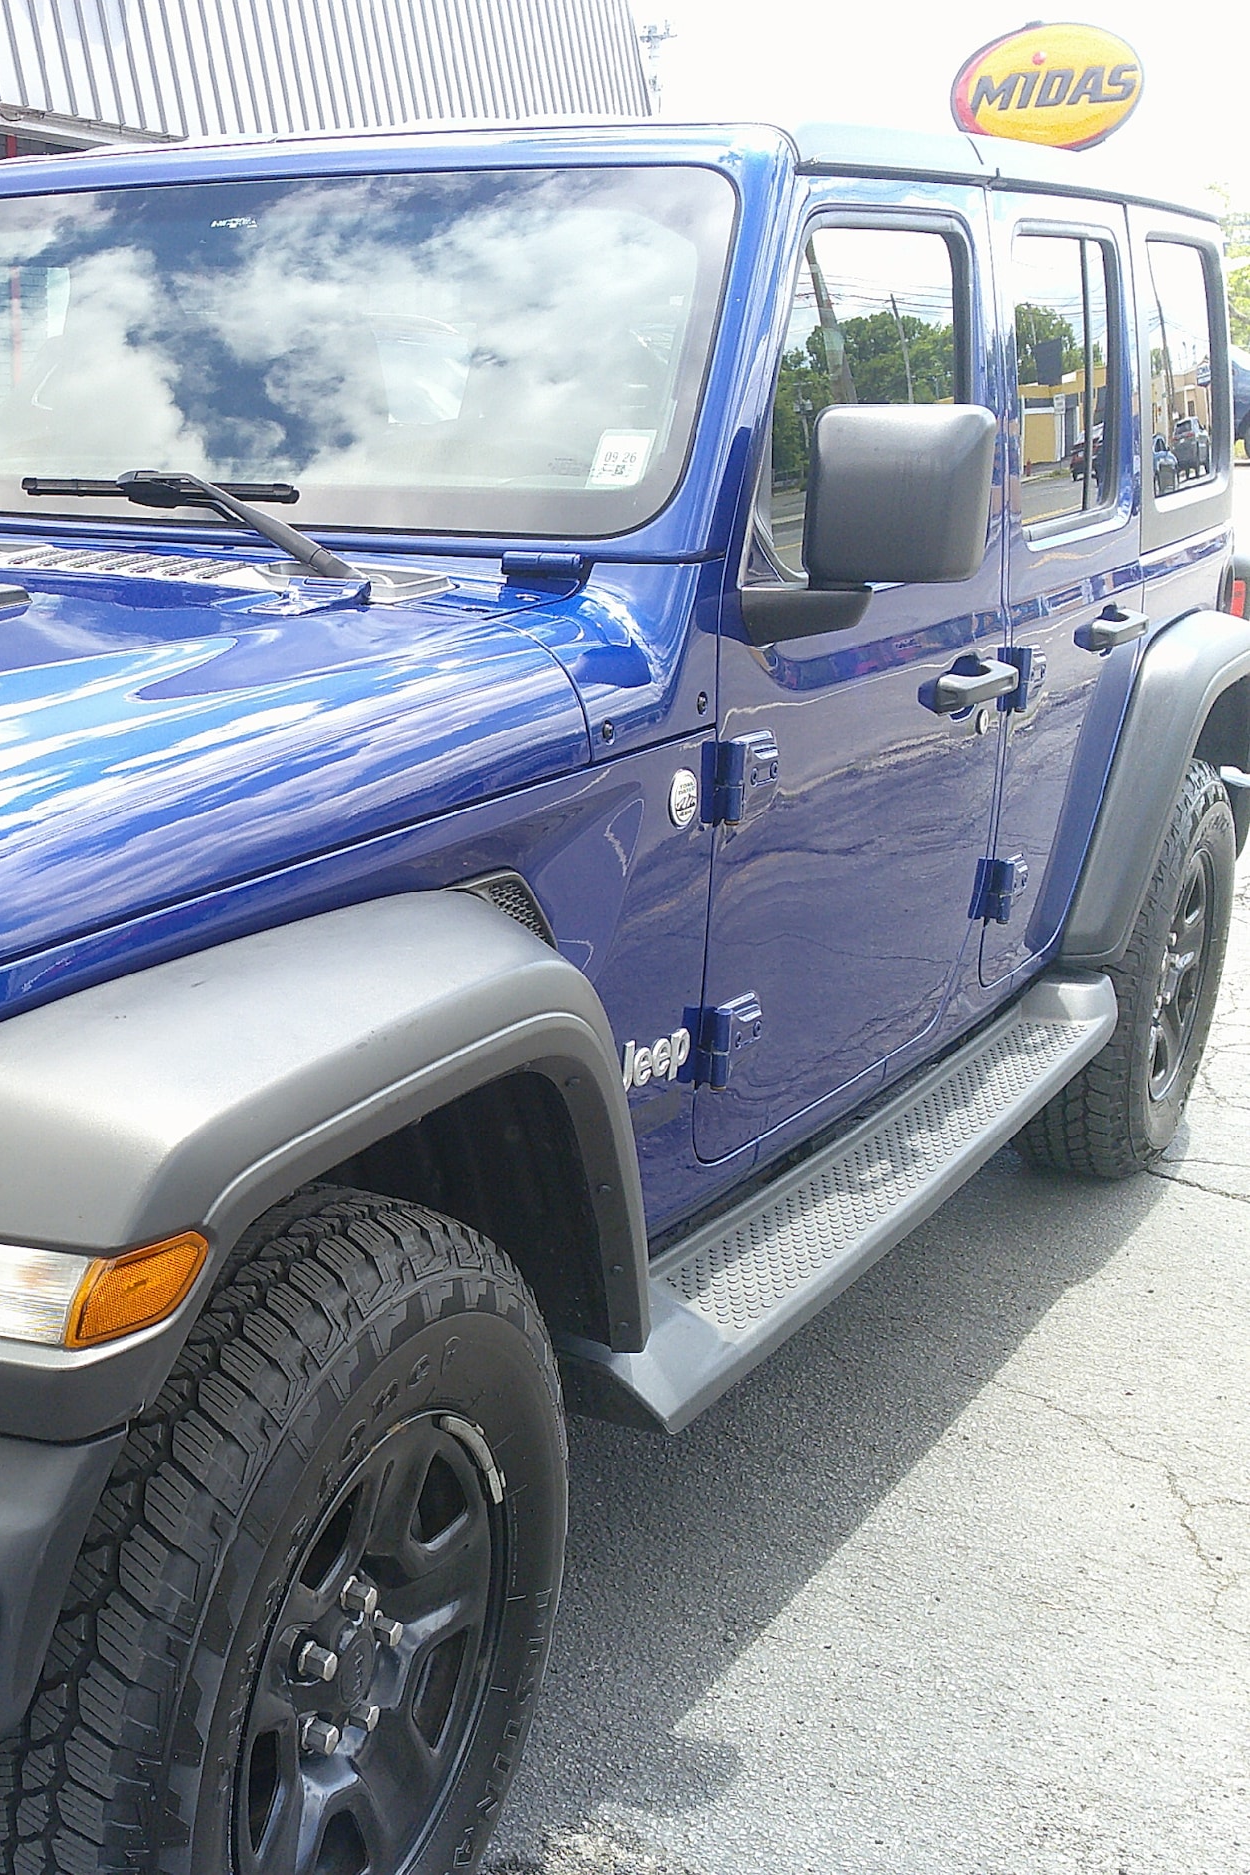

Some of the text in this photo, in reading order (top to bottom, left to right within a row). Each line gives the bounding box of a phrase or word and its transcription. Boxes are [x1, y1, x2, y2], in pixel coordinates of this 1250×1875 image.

[970, 62, 1138, 118] MIDAS
[604, 451, 637, 463] 09 26
[622, 1027, 691, 1092] Jeep
